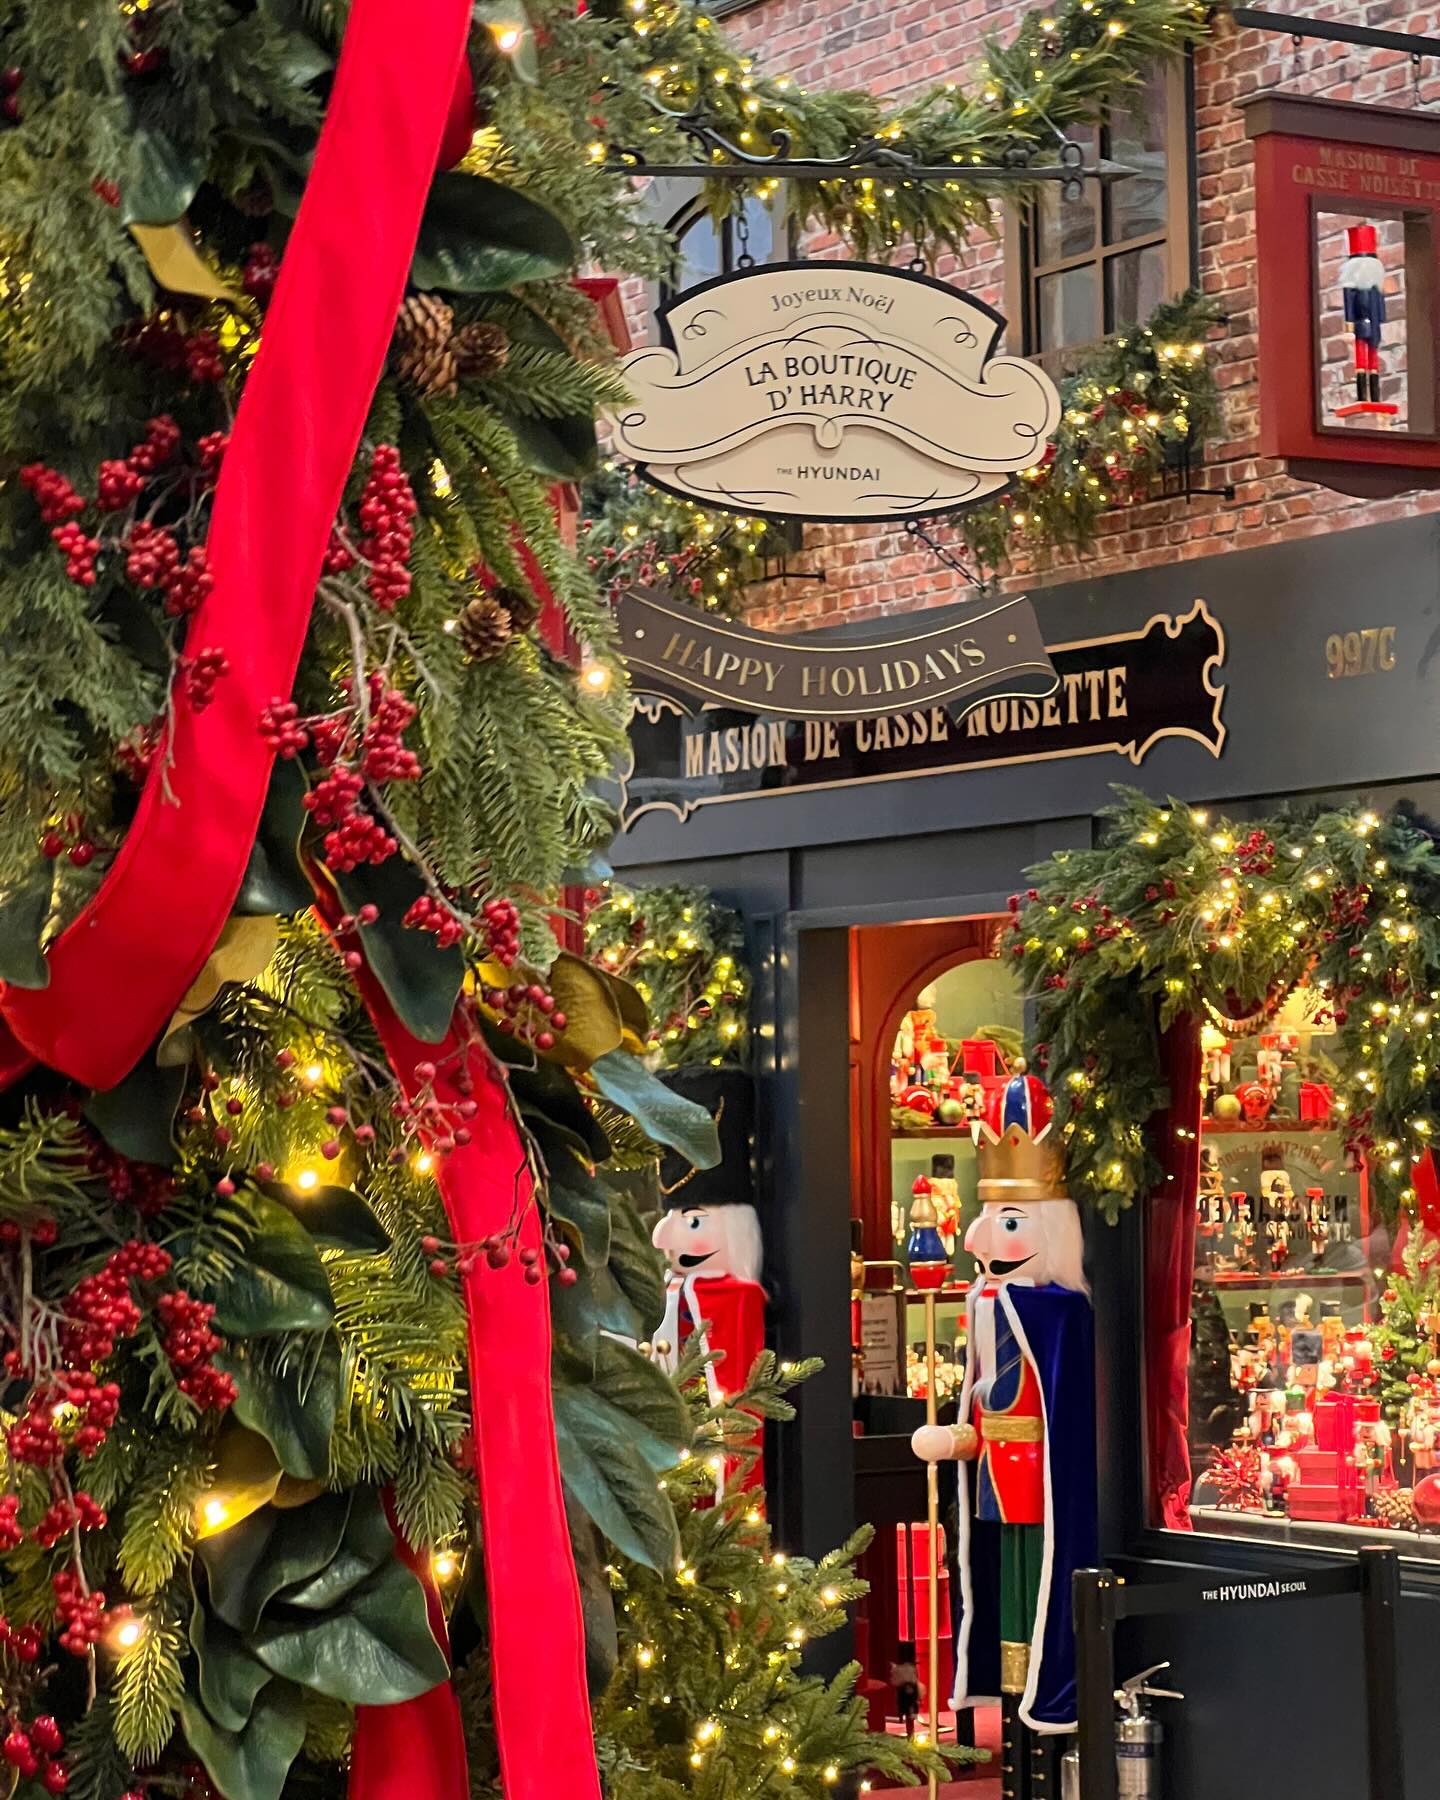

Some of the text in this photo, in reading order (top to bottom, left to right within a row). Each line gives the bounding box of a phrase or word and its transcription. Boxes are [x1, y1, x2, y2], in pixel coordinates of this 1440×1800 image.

[770, 285, 895, 315] Joyeux Noël
[744, 354, 917, 390] LA BOUTIQUE
[797, 465, 880, 480] HYUNDAI
[660, 632, 986, 697] HAPPY HOLIDAYS
[683, 720, 788, 779] MASION
[804, 720, 841, 761] DE
[1202, 1581, 1307, 1601] THE HYUNDAI SEOUL
